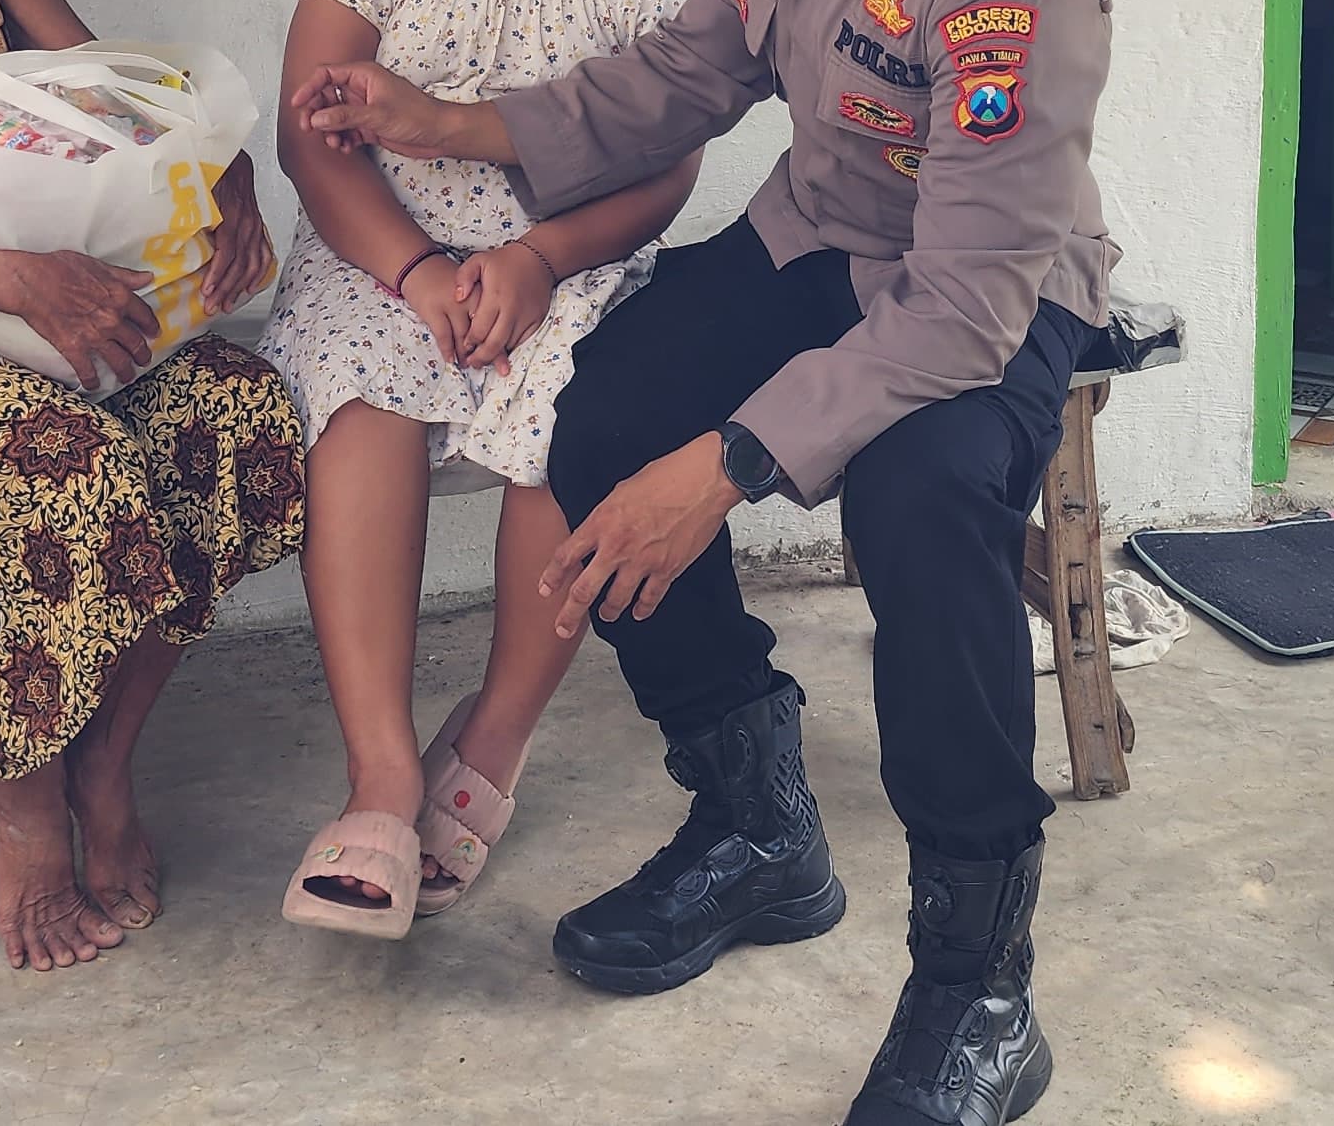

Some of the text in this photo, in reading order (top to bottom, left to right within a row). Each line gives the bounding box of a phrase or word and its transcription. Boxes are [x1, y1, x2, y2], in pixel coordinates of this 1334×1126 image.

[946, 8, 1031, 34] POLRESTA
[950, 20, 1030, 43] SIDOARJO
[834, 19, 930, 87] POLRI
[960, 50, 1021, 67] JAWA TIMUR
